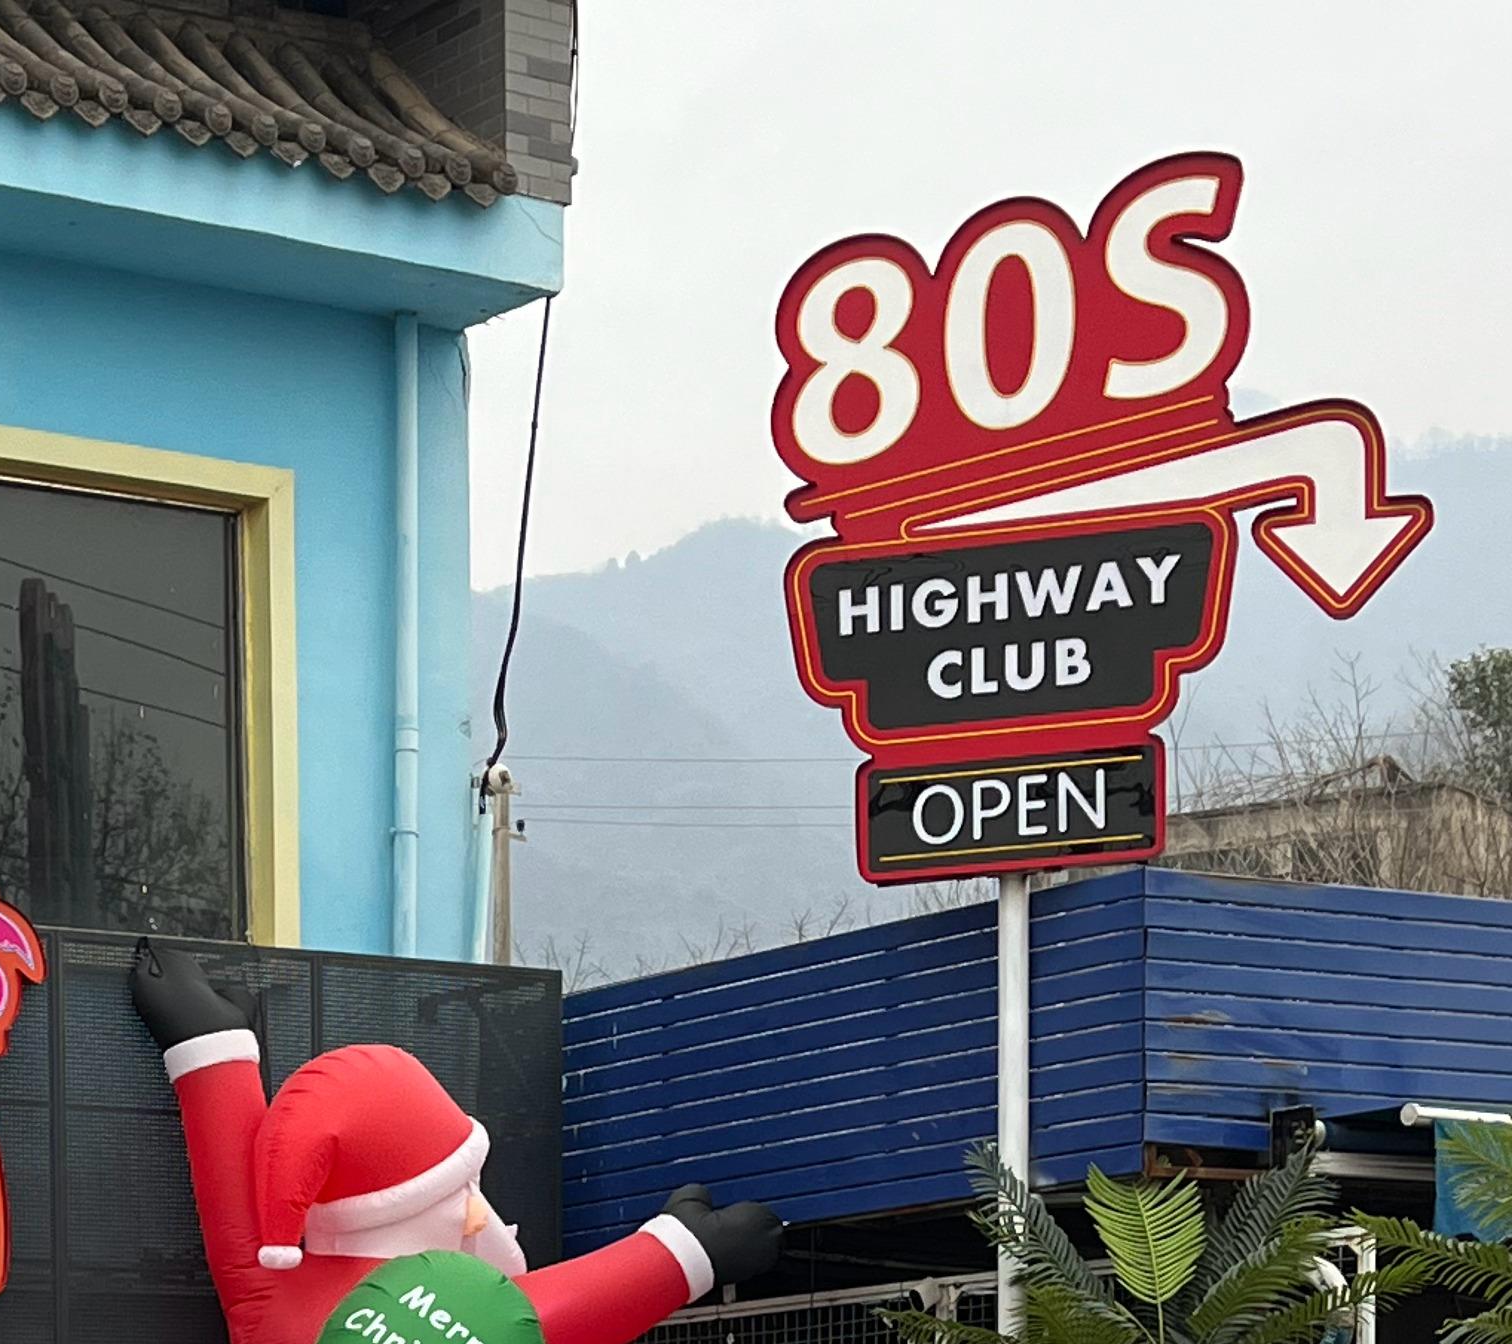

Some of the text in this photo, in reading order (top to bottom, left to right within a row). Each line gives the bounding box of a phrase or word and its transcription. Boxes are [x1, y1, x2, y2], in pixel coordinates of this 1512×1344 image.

[790, 174, 1230, 467] 80S
[837, 553, 1182, 636] HIGHWAY
[926, 638, 1092, 699] CLUB
[911, 767, 1108, 846] OPEN
